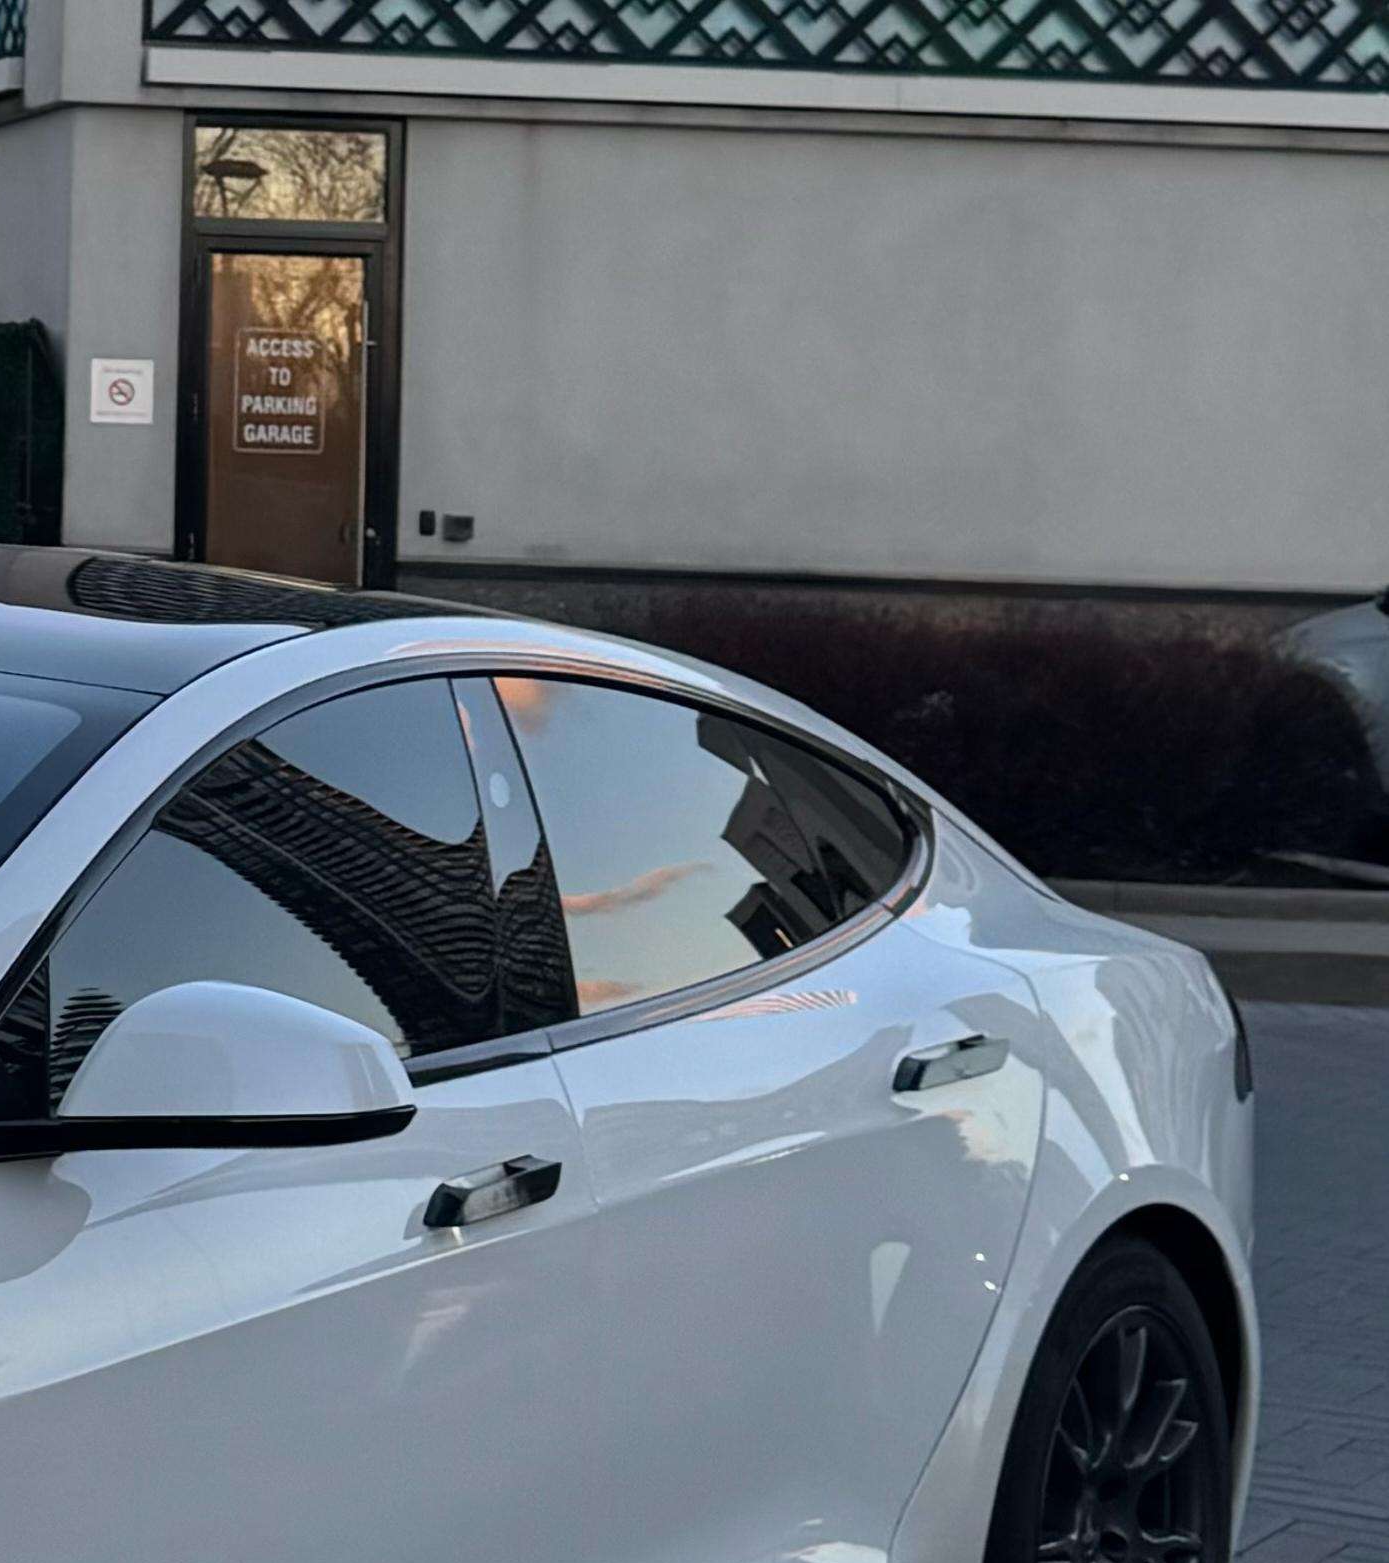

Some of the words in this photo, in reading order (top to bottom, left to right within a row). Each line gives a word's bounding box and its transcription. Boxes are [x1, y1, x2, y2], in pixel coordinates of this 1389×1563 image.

[246, 338, 315, 359] ACCESS
[268, 366, 292, 387] TO
[241, 394, 318, 416] PARKING
[243, 423, 314, 445] GARAGE
